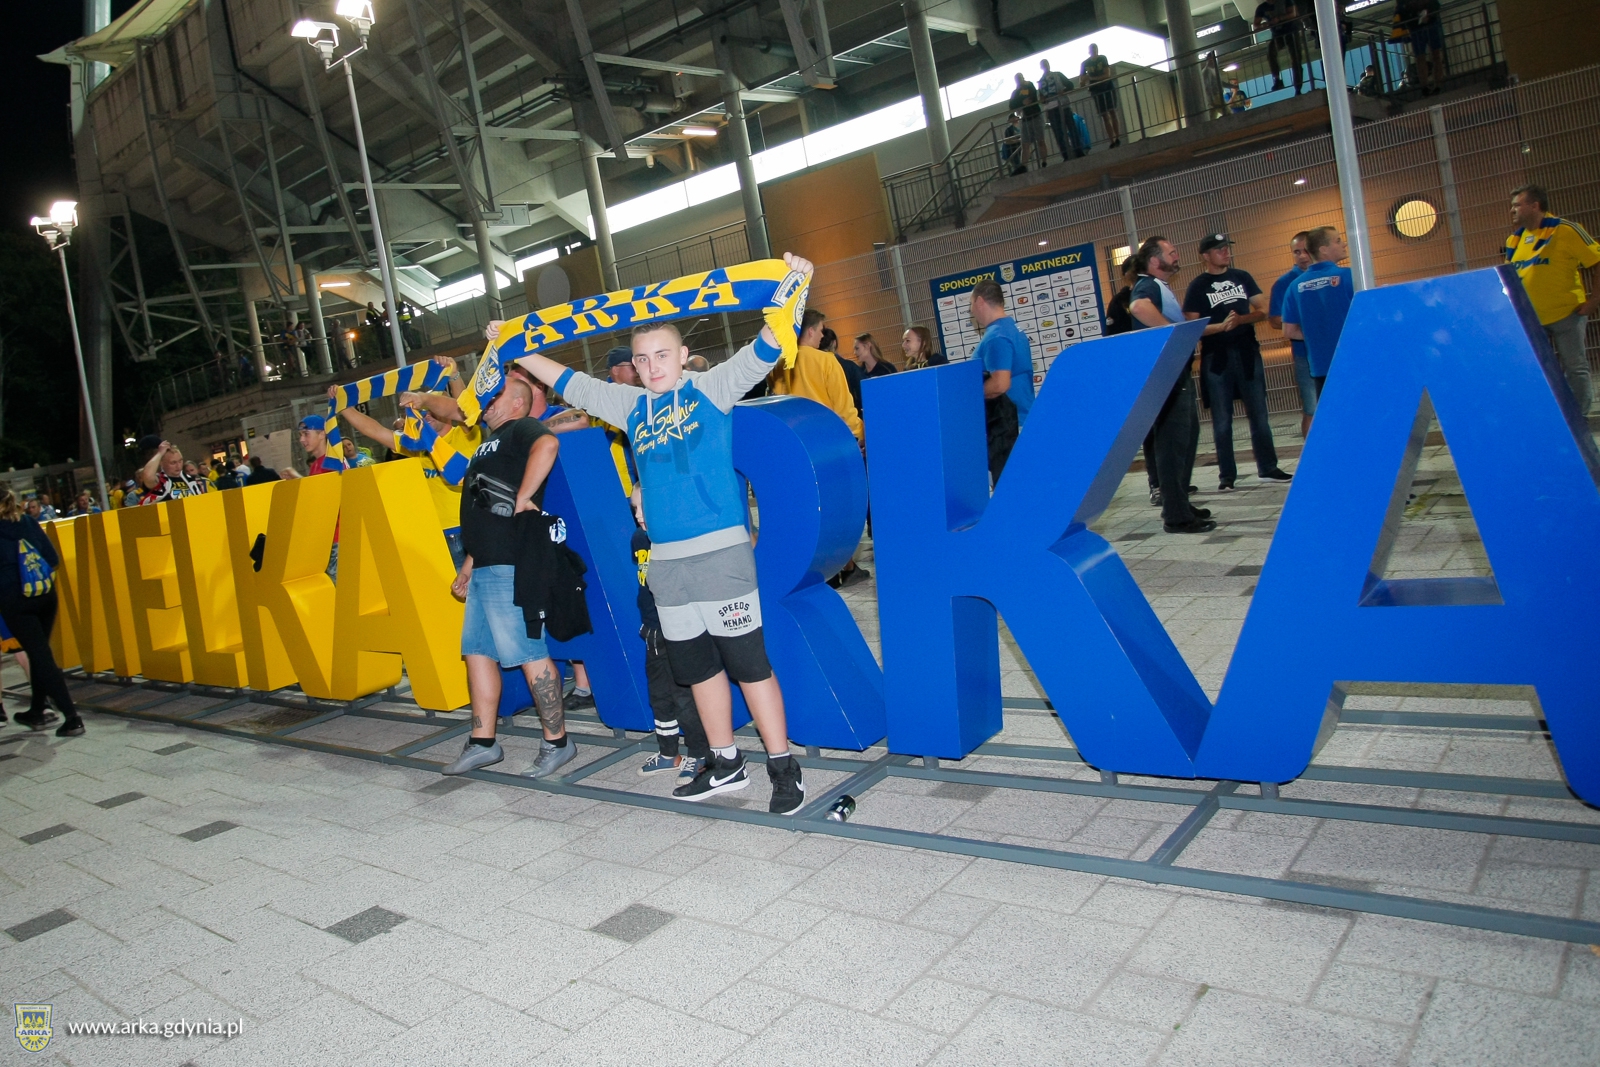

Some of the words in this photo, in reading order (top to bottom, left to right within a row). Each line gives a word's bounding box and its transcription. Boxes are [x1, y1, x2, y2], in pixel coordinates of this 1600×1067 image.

[1196, 25, 1221, 38] SEKTOR
[1021, 252, 1082, 274] PARTNERZY
[939, 272, 996, 293] SPONSORZY
[1206, 284, 1248, 308] LONSDALE
[524, 268, 740, 353] ARKA
[45, 457, 471, 712] WIELKA
[718, 601, 750, 617] SPEEDS
